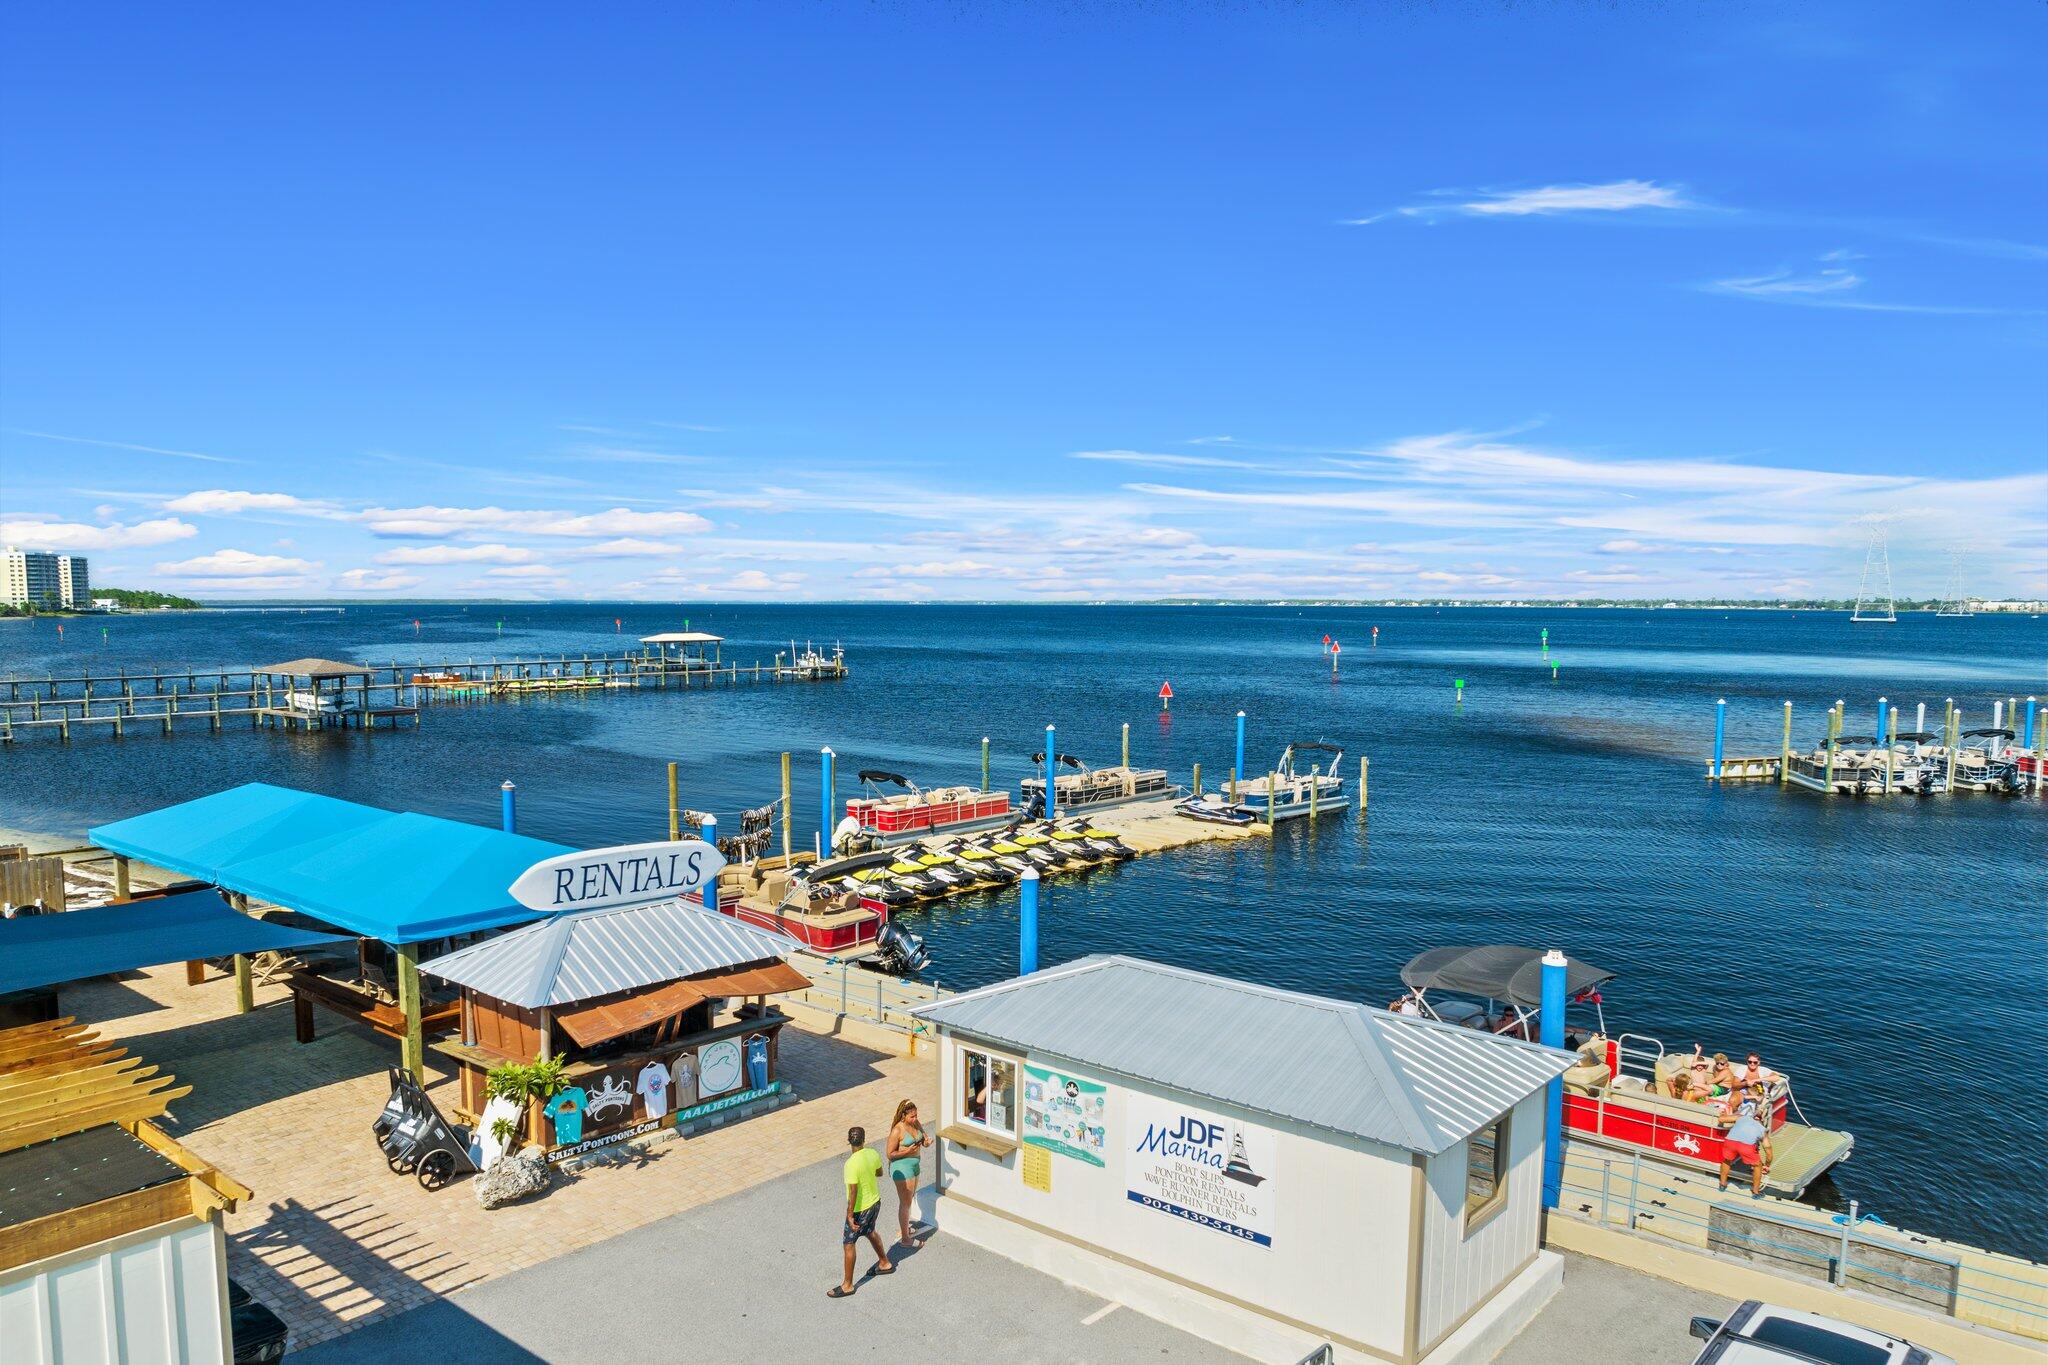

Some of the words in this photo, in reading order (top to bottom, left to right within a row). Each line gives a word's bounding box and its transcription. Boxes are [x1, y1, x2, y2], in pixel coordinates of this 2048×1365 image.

[552, 851, 703, 905] RENTALS
[1136, 1123, 1224, 1169] Marina
[1169, 1115, 1225, 1148] JDF
[1155, 1166, 1199, 1186] PONTOON
[1201, 1180, 1246, 1203] RENTALS
[1175, 1162, 1198, 1179] BOAT
[1200, 1169, 1225, 1185] SLIPS
[1144, 1172, 1168, 1188] WAVE
[1170, 1179, 1210, 1200] RUNNER
[1213, 1193, 1258, 1217] RENTALS
[1161, 1188, 1203, 1210] DOLPHIN
[1206, 1202, 1238, 1220] TOURS
[1142, 1196, 1255, 1241] 904-439-5445
